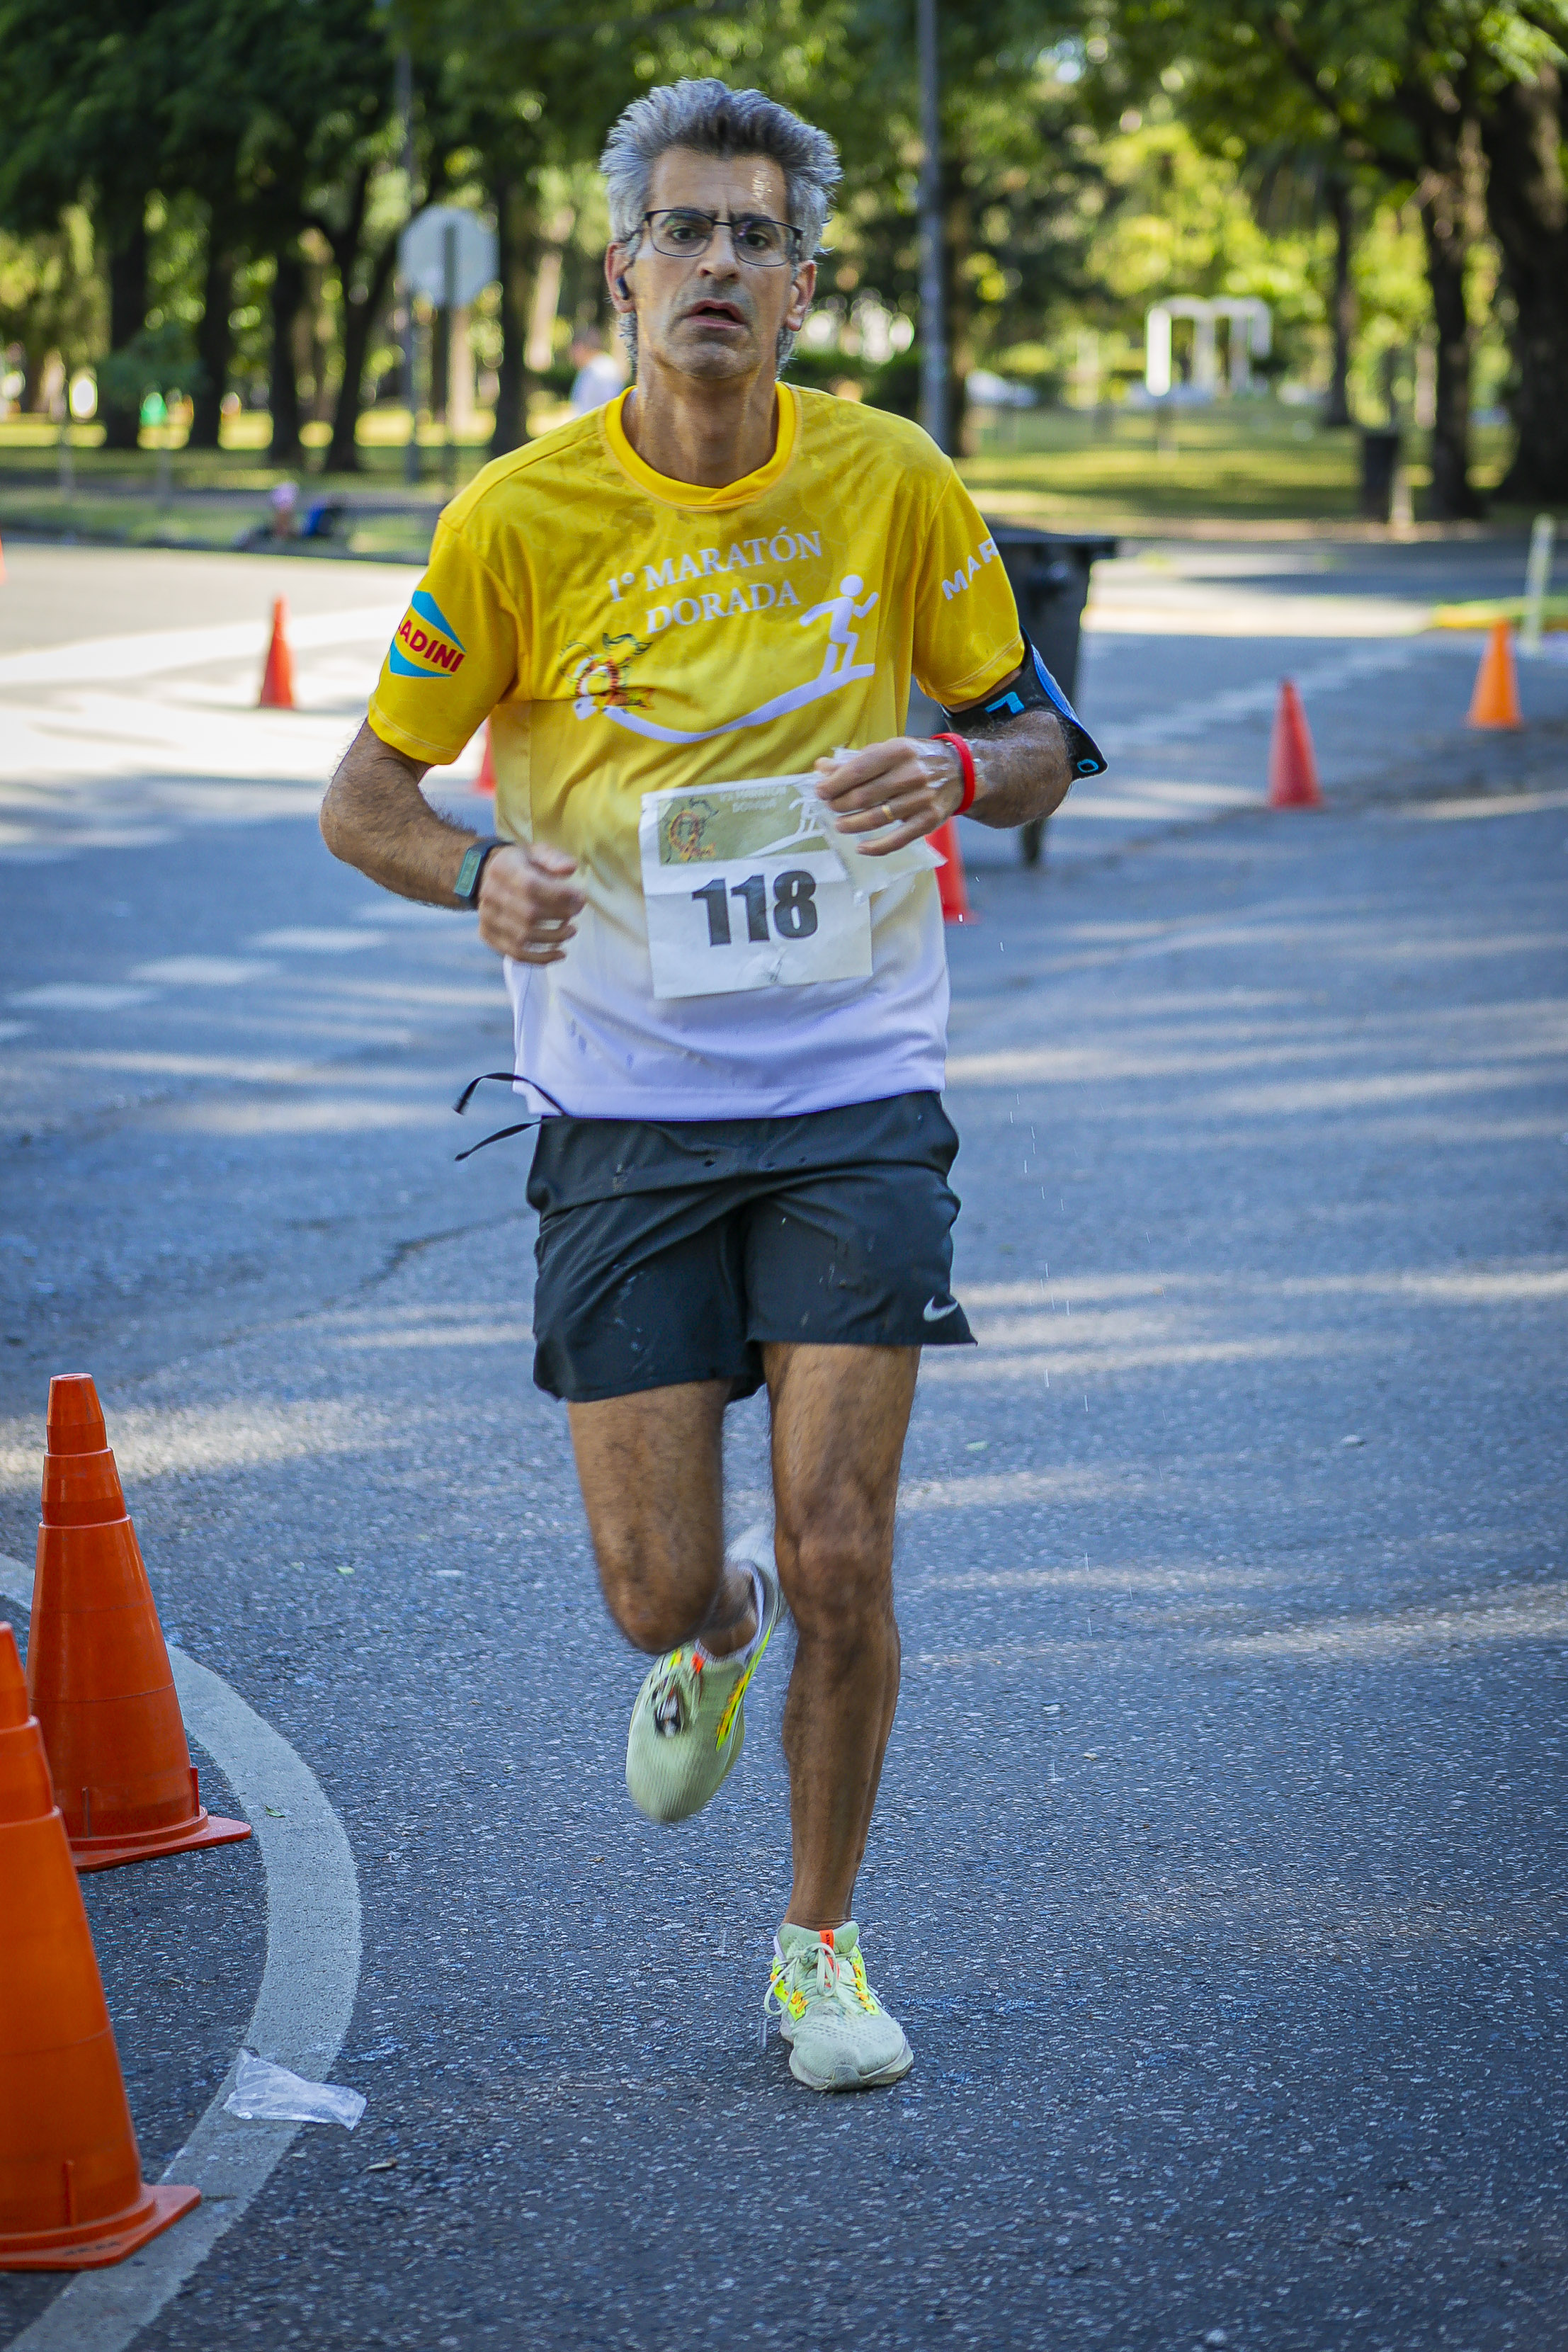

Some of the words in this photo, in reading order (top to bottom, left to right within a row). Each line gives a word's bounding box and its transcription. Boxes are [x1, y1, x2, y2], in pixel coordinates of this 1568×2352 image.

[643, 526, 822, 592] MARATÓN
[647, 580, 800, 635] DORADA
[398, 619, 465, 673] ADINI
[691, 870, 818, 947] 118
